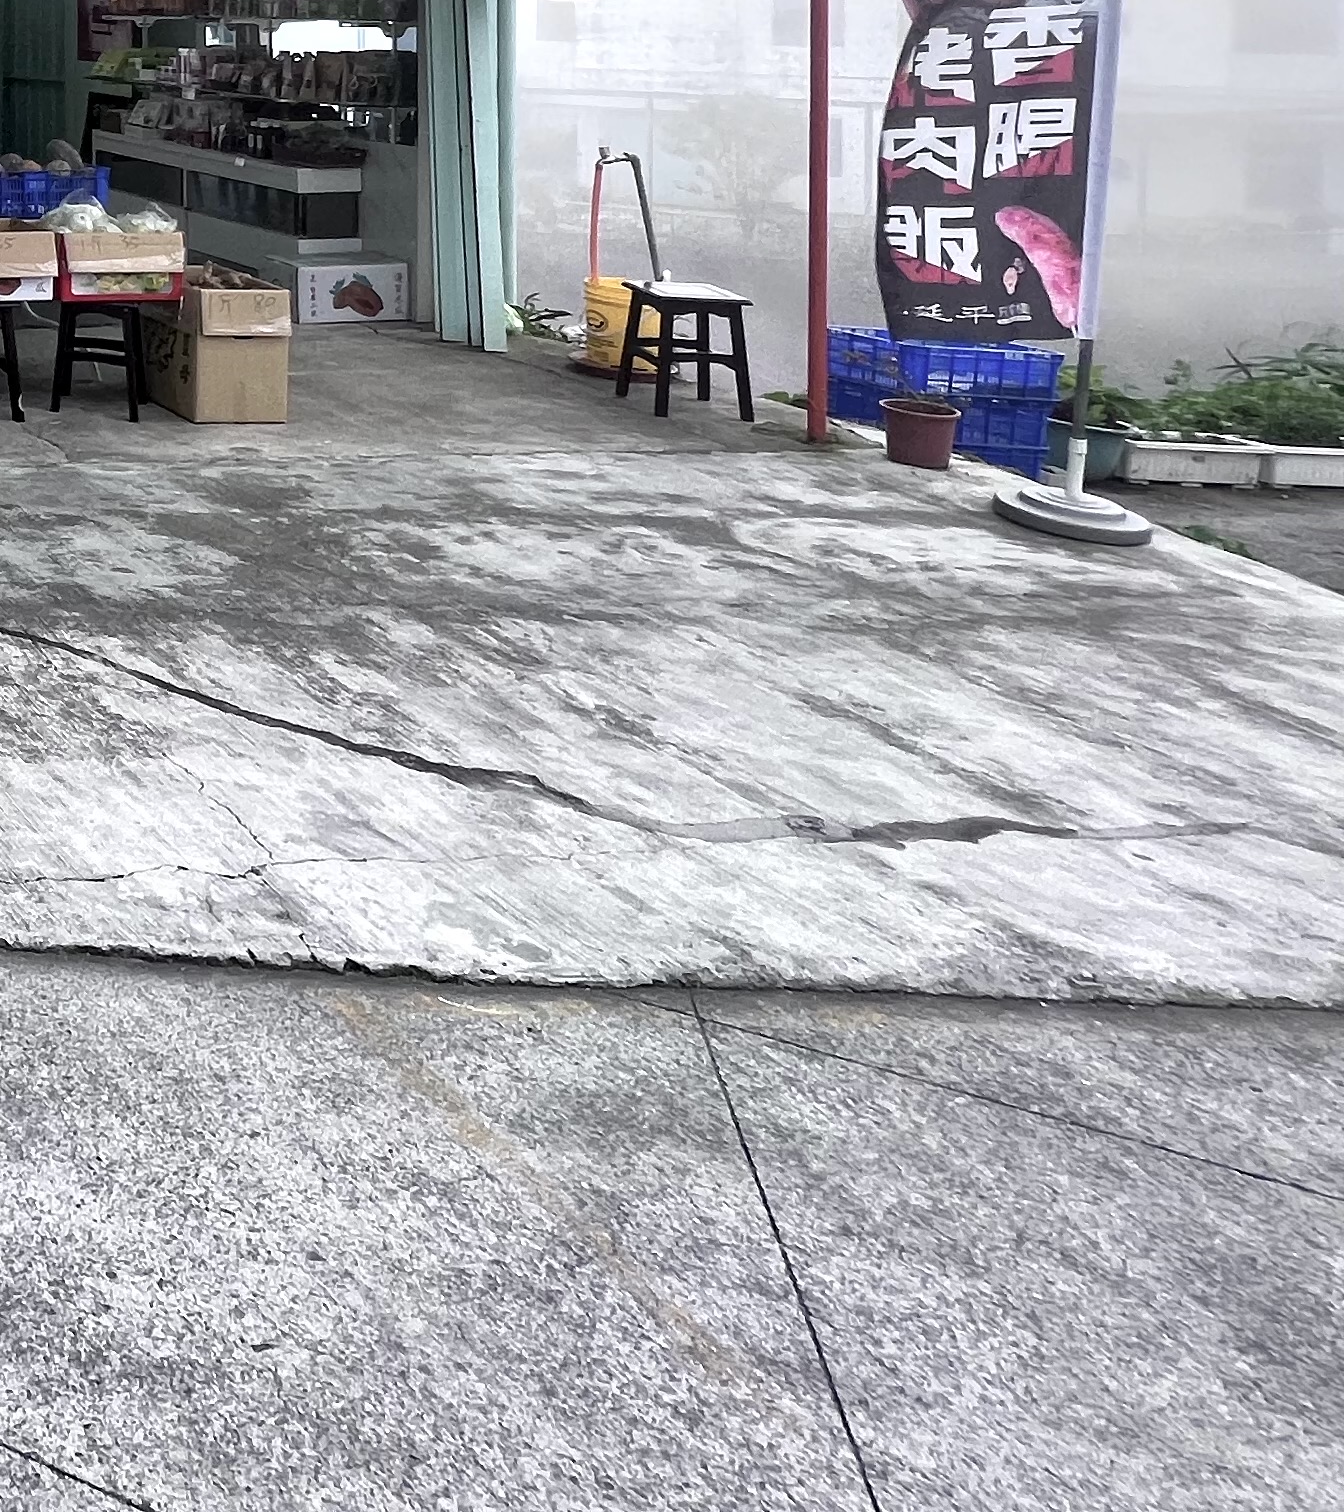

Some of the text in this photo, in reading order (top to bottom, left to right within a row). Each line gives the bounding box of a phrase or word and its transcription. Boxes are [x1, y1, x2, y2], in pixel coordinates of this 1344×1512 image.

[883, 26, 982, 284] 烤肉飯
[982, 3, 1084, 180] 香腸
[902, 303, 996, 325] 延平
